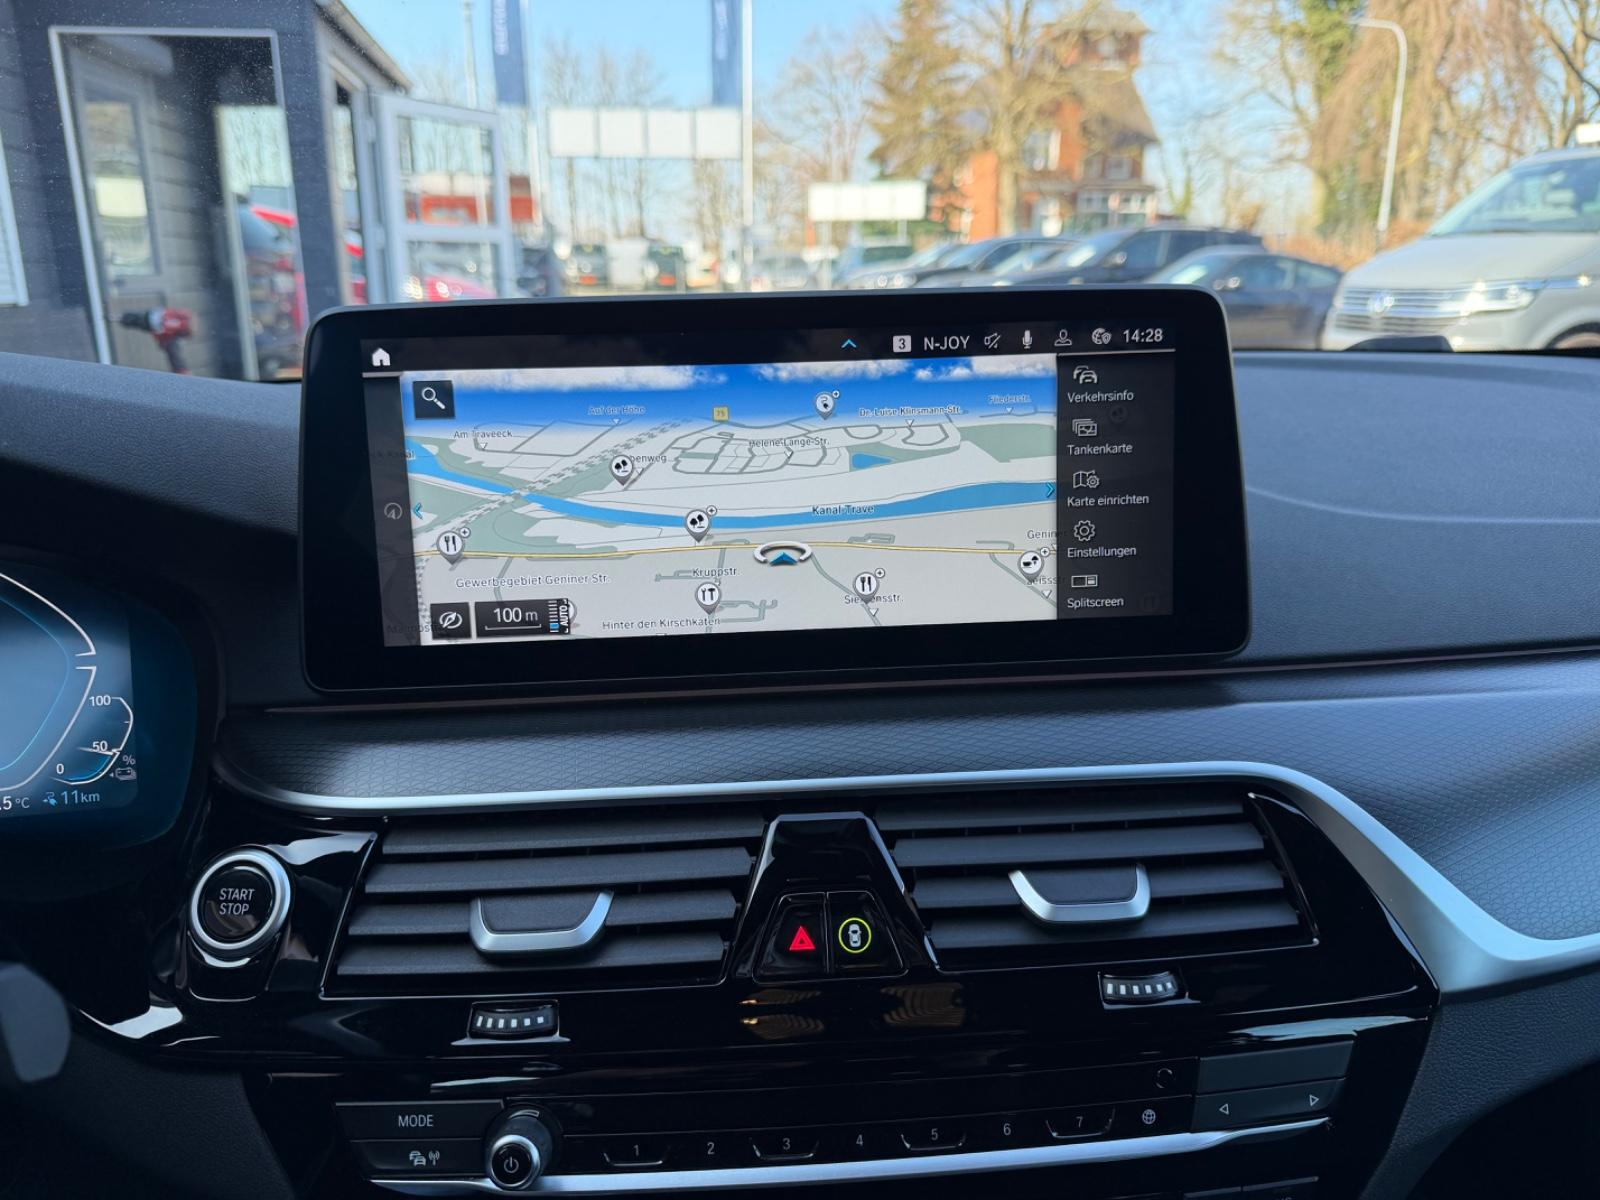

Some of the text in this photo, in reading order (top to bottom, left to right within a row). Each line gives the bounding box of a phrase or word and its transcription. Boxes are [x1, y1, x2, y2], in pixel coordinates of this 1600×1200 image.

[897, 335, 970, 351] 3 N-JOY
[1122, 328, 1164, 344] 14:28
[1067, 390, 1135, 403] Verkehrsinfo
[453, 430, 469, 439] Am
[1067, 443, 1133, 456] Tankenkarte
[1067, 493, 1150, 508] Karte einrichten
[1067, 545, 1137, 559] Einstellungen
[692, 566, 740, 578] Kruppstr.
[455, 572, 611, 589] Gewerbegebiet Geniner Str.
[844, 594, 904, 605] Sieensstr.
[1066, 597, 1125, 611] Splitscreen
[493, 607, 538, 624] 100 m
[559, 604, 569, 626] AUTO
[602, 620, 635, 631] Hinter
[637, 618, 657, 630] den
[89, 694, 112, 707] 100
[92, 740, 109, 752] 50
[122, 754, 136, 766] %
[56, 763, 65, 775] 0
[219, 887, 256, 901] START
[219, 902, 250, 915] STOP
[397, 1114, 435, 1129] MODE
[1075, 1115, 1084, 1128] 7
[930, 1127, 940, 1142] 5
[1002, 1122, 1012, 1138] 6
[781, 1136, 792, 1152] 3
[855, 1133, 865, 1148] 4
[632, 1144, 641, 1158] 1
[706, 1141, 716, 1156] 2
